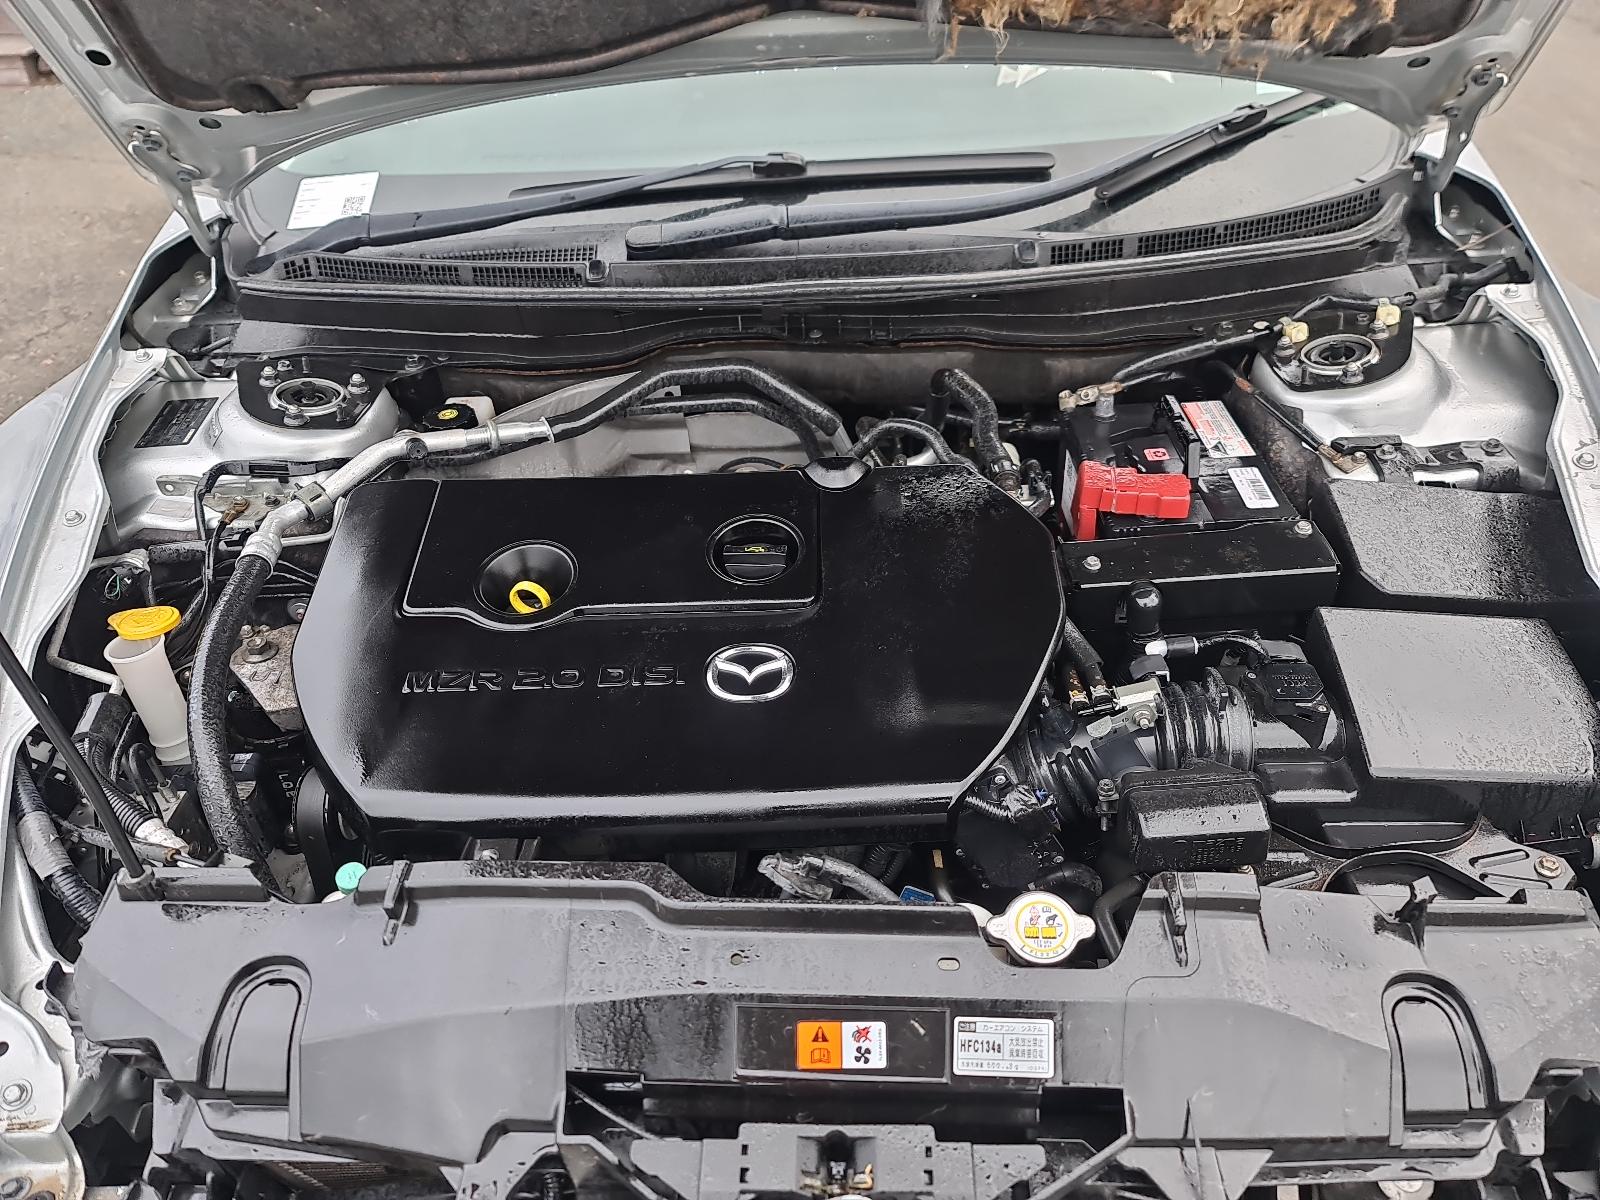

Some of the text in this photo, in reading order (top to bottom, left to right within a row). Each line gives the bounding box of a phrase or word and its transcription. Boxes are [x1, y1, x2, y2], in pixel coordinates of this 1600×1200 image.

[401, 670, 503, 693] MZR
[512, 668, 585, 690] 2.0
[960, 1039, 1002, 1054] HFC134a
